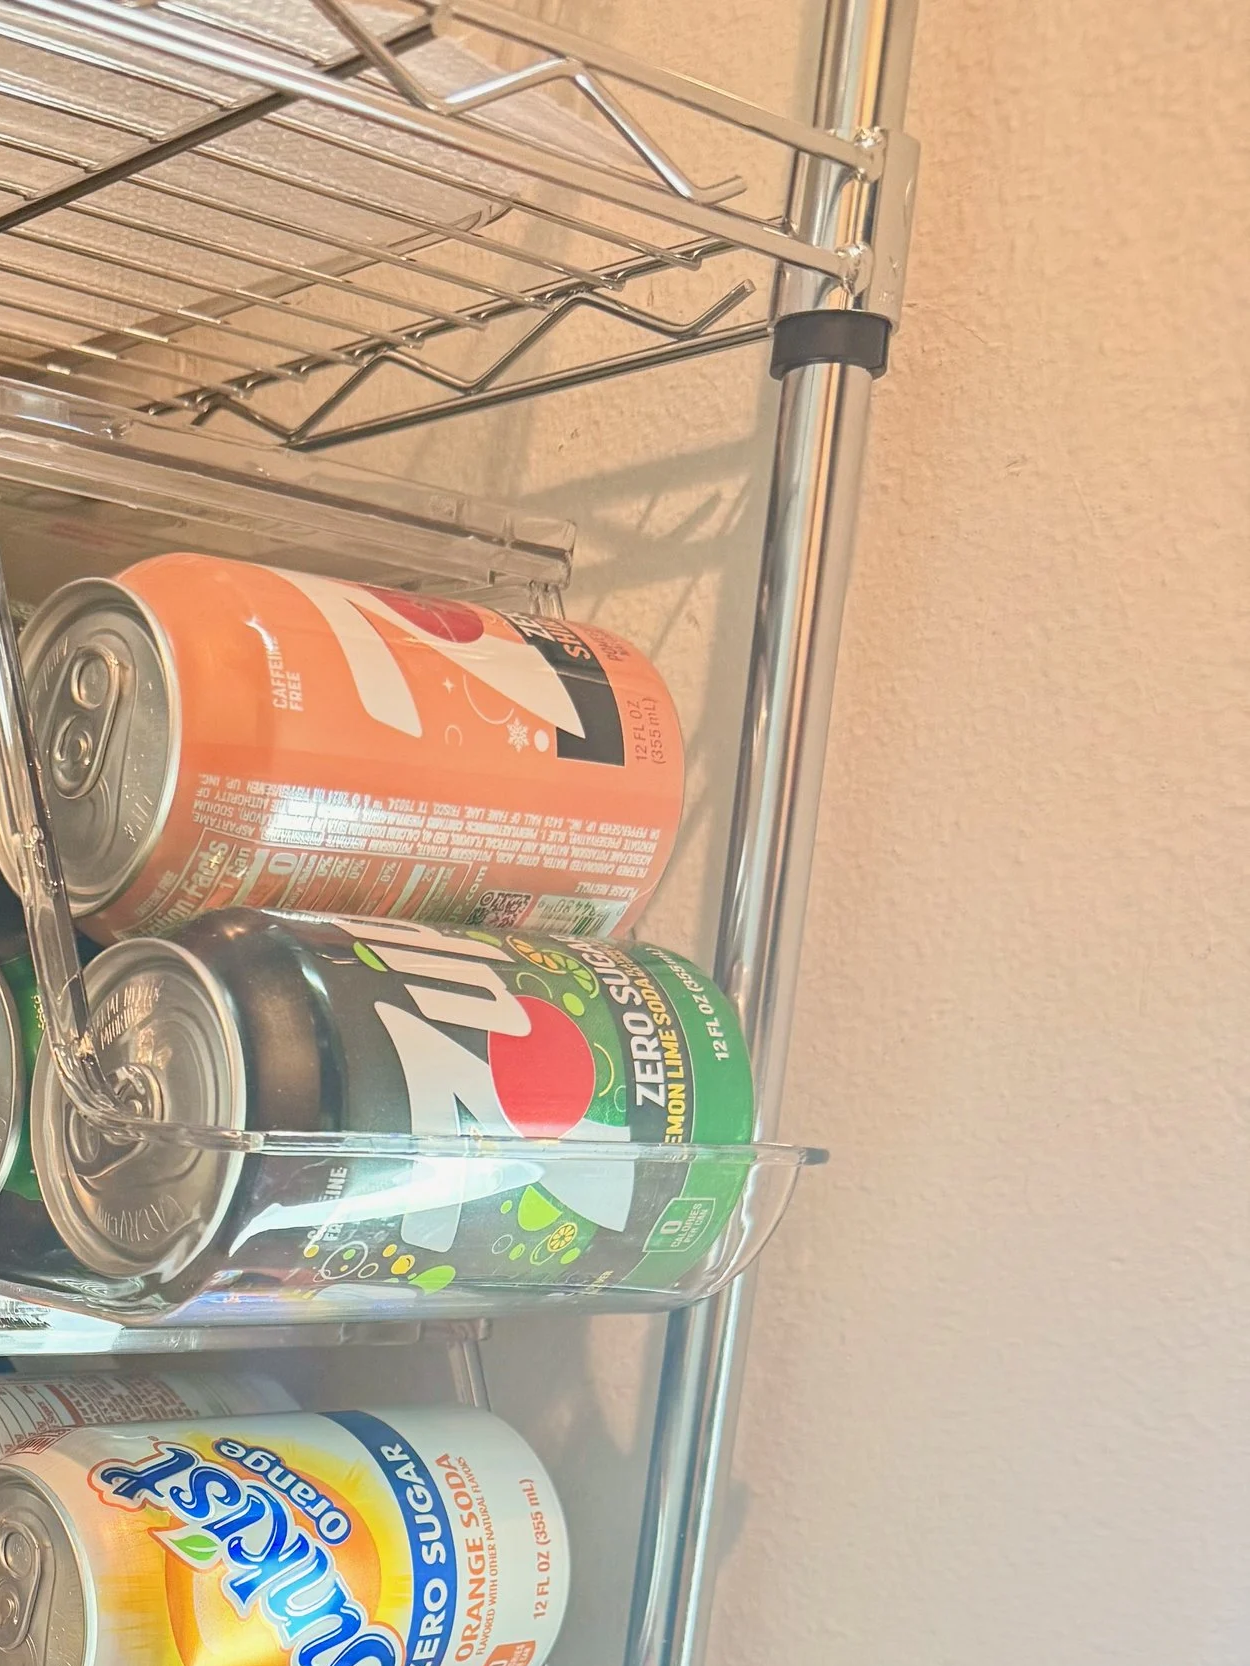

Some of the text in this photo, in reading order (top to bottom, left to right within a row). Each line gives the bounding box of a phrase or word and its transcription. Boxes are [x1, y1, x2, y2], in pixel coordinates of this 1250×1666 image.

[287, 672, 303, 709] FREE
[627, 700, 647, 760] 12 FL OZ
[646, 729, 666, 762] (355
[179, 836, 230, 898] Facts
[693, 993, 713, 1014] OZ
[707, 1018, 723, 1036] FL
[624, 1010, 665, 1106] ZERO
[642, 976, 684, 1143] EMON LIME SODA
[714, 1041, 728, 1059] 12
[659, 1221, 682, 1232] 0
[214, 1437, 350, 1546] Orange
[380, 1443, 446, 1565] SUGAR
[474, 1495, 495, 1540] NATURAL
[435, 1453, 488, 1661] ORANGE SODA
[488, 1544, 497, 1575] OTHER
[519, 1477, 551, 1618] 12 FL OZ (355 mL)
[487, 1579, 497, 1605] WITH
[475, 1608, 495, 1654] FLAVORED
